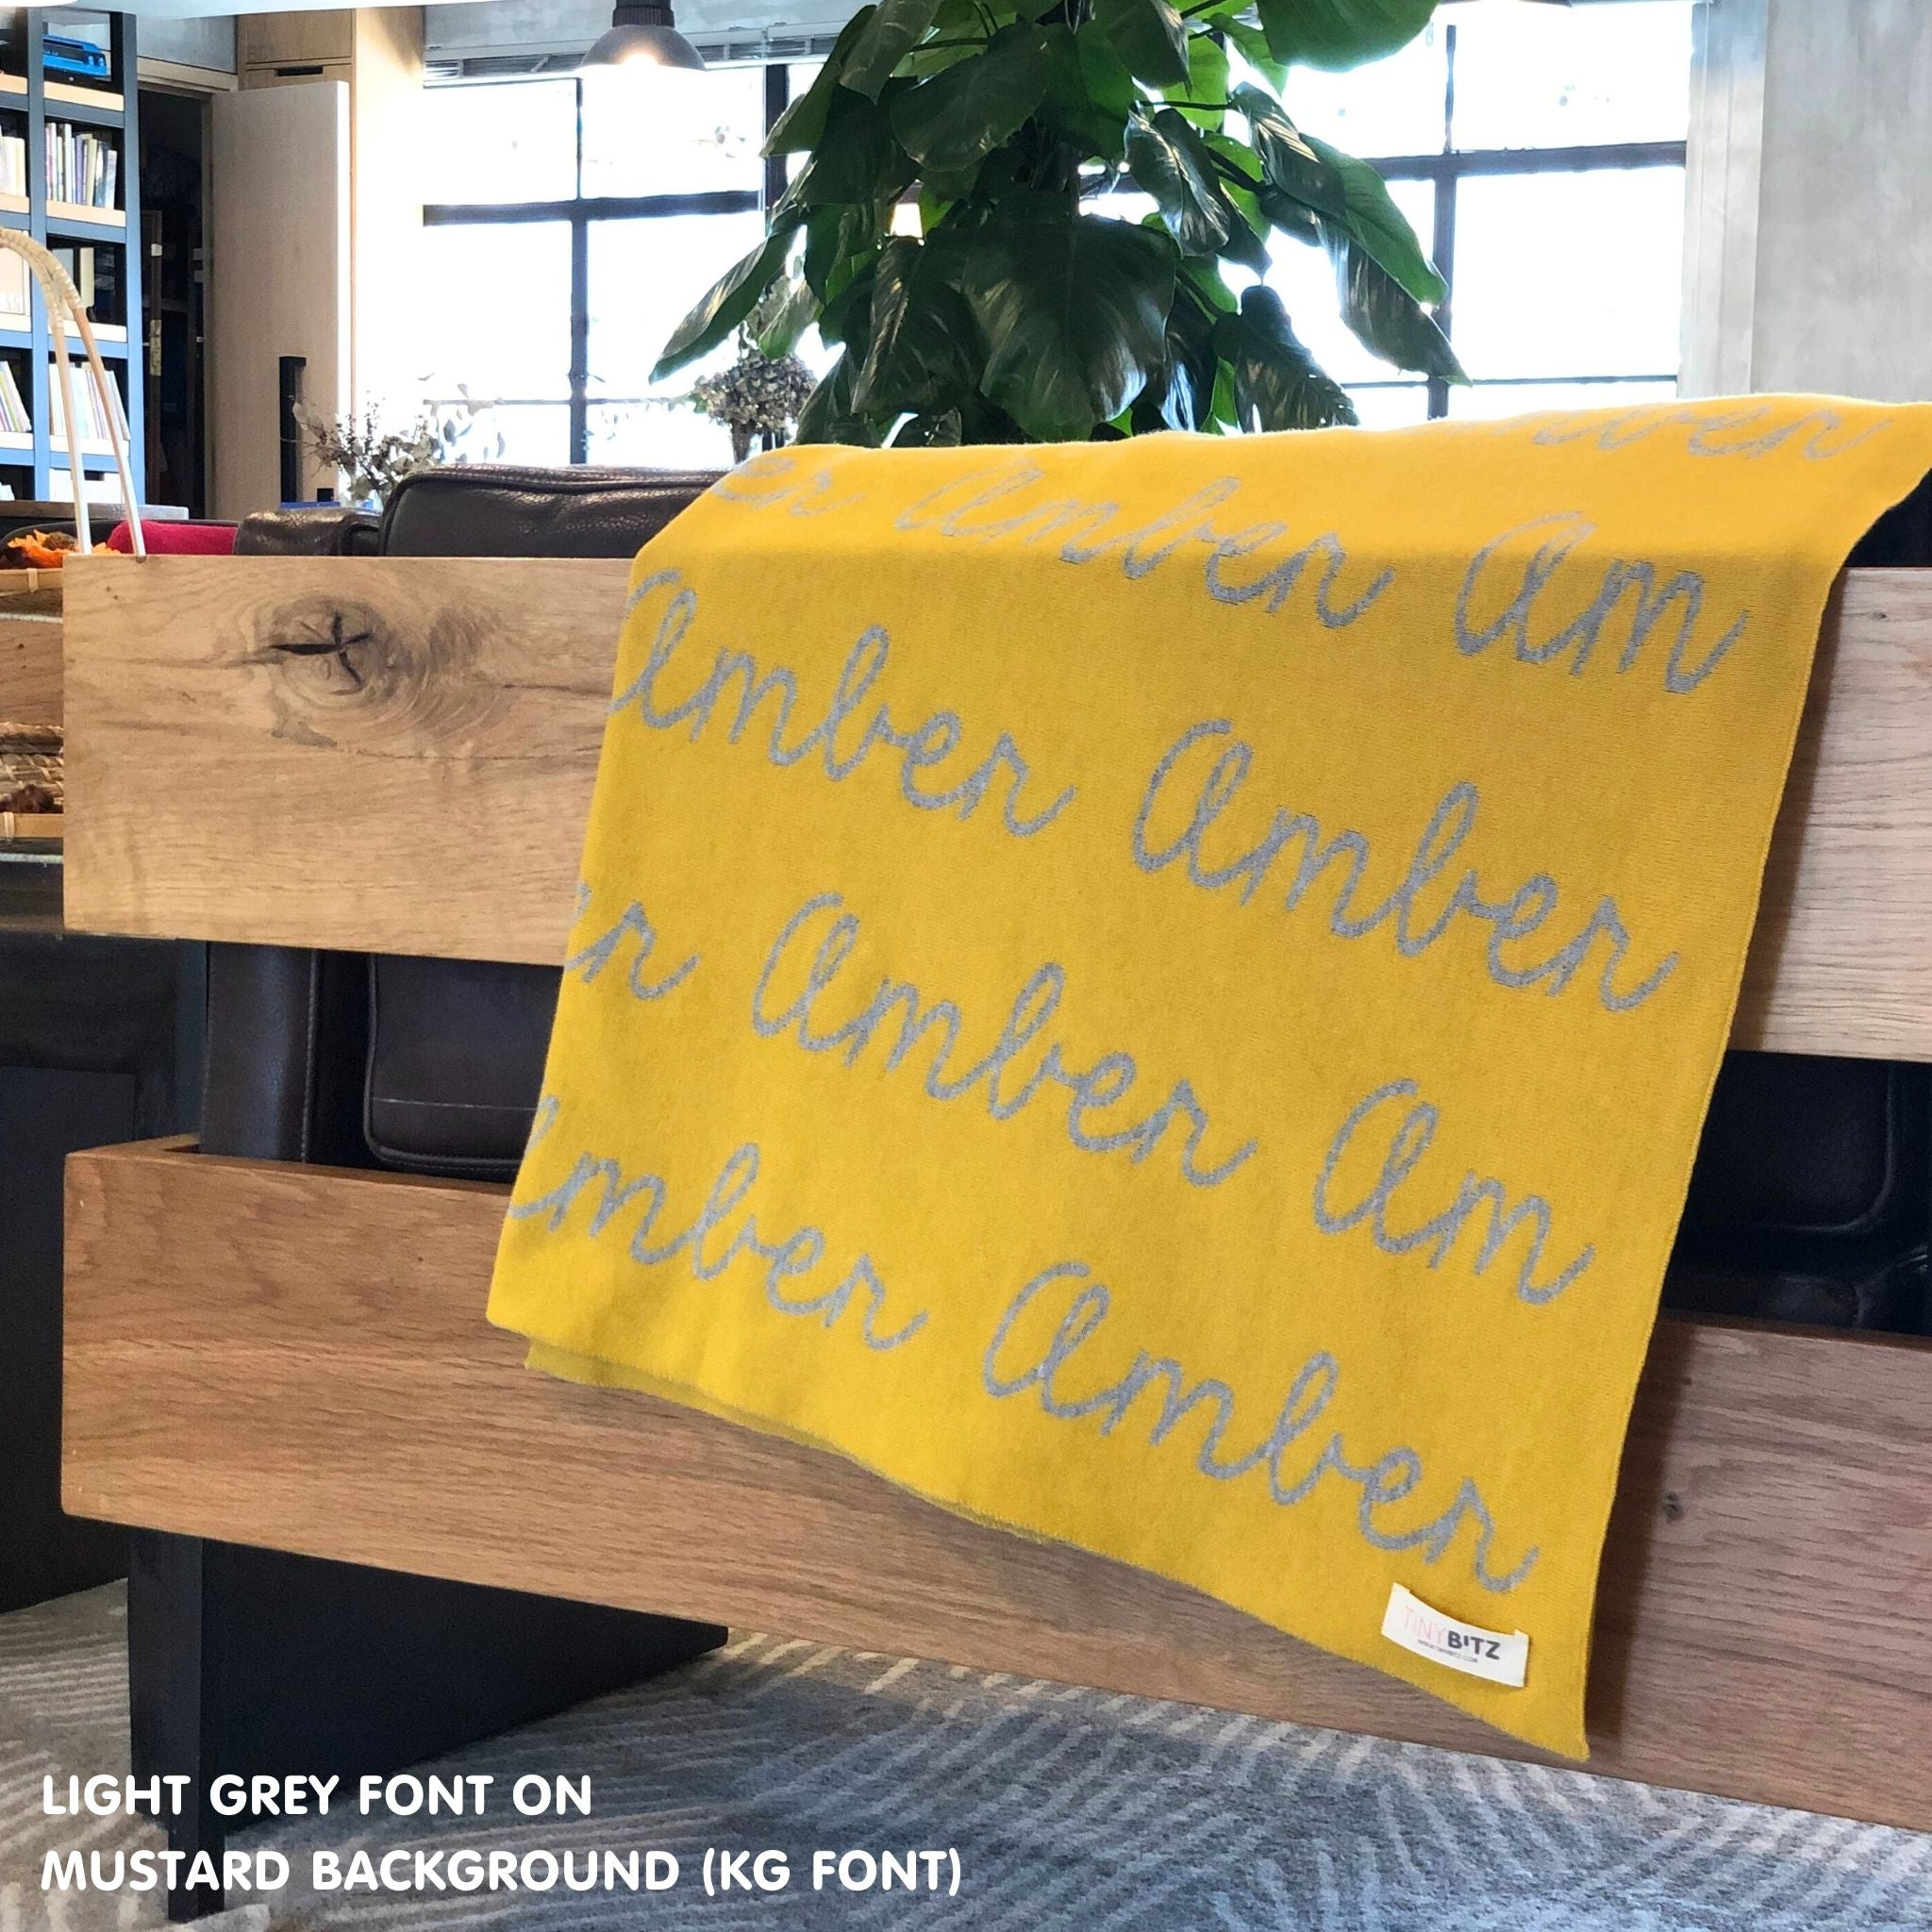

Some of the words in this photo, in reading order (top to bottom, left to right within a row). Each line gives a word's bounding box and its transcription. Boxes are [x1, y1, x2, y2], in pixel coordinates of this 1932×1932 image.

[894, 458, 1394, 629] Amber
[1455, 513, 1748, 694] Am
[1132, 719, 1679, 1012] Amber
[753, 892, 1257, 1188] Amber
[1313, 1078, 1595, 1306] Am
[983, 1261, 1540, 1592] Amber
